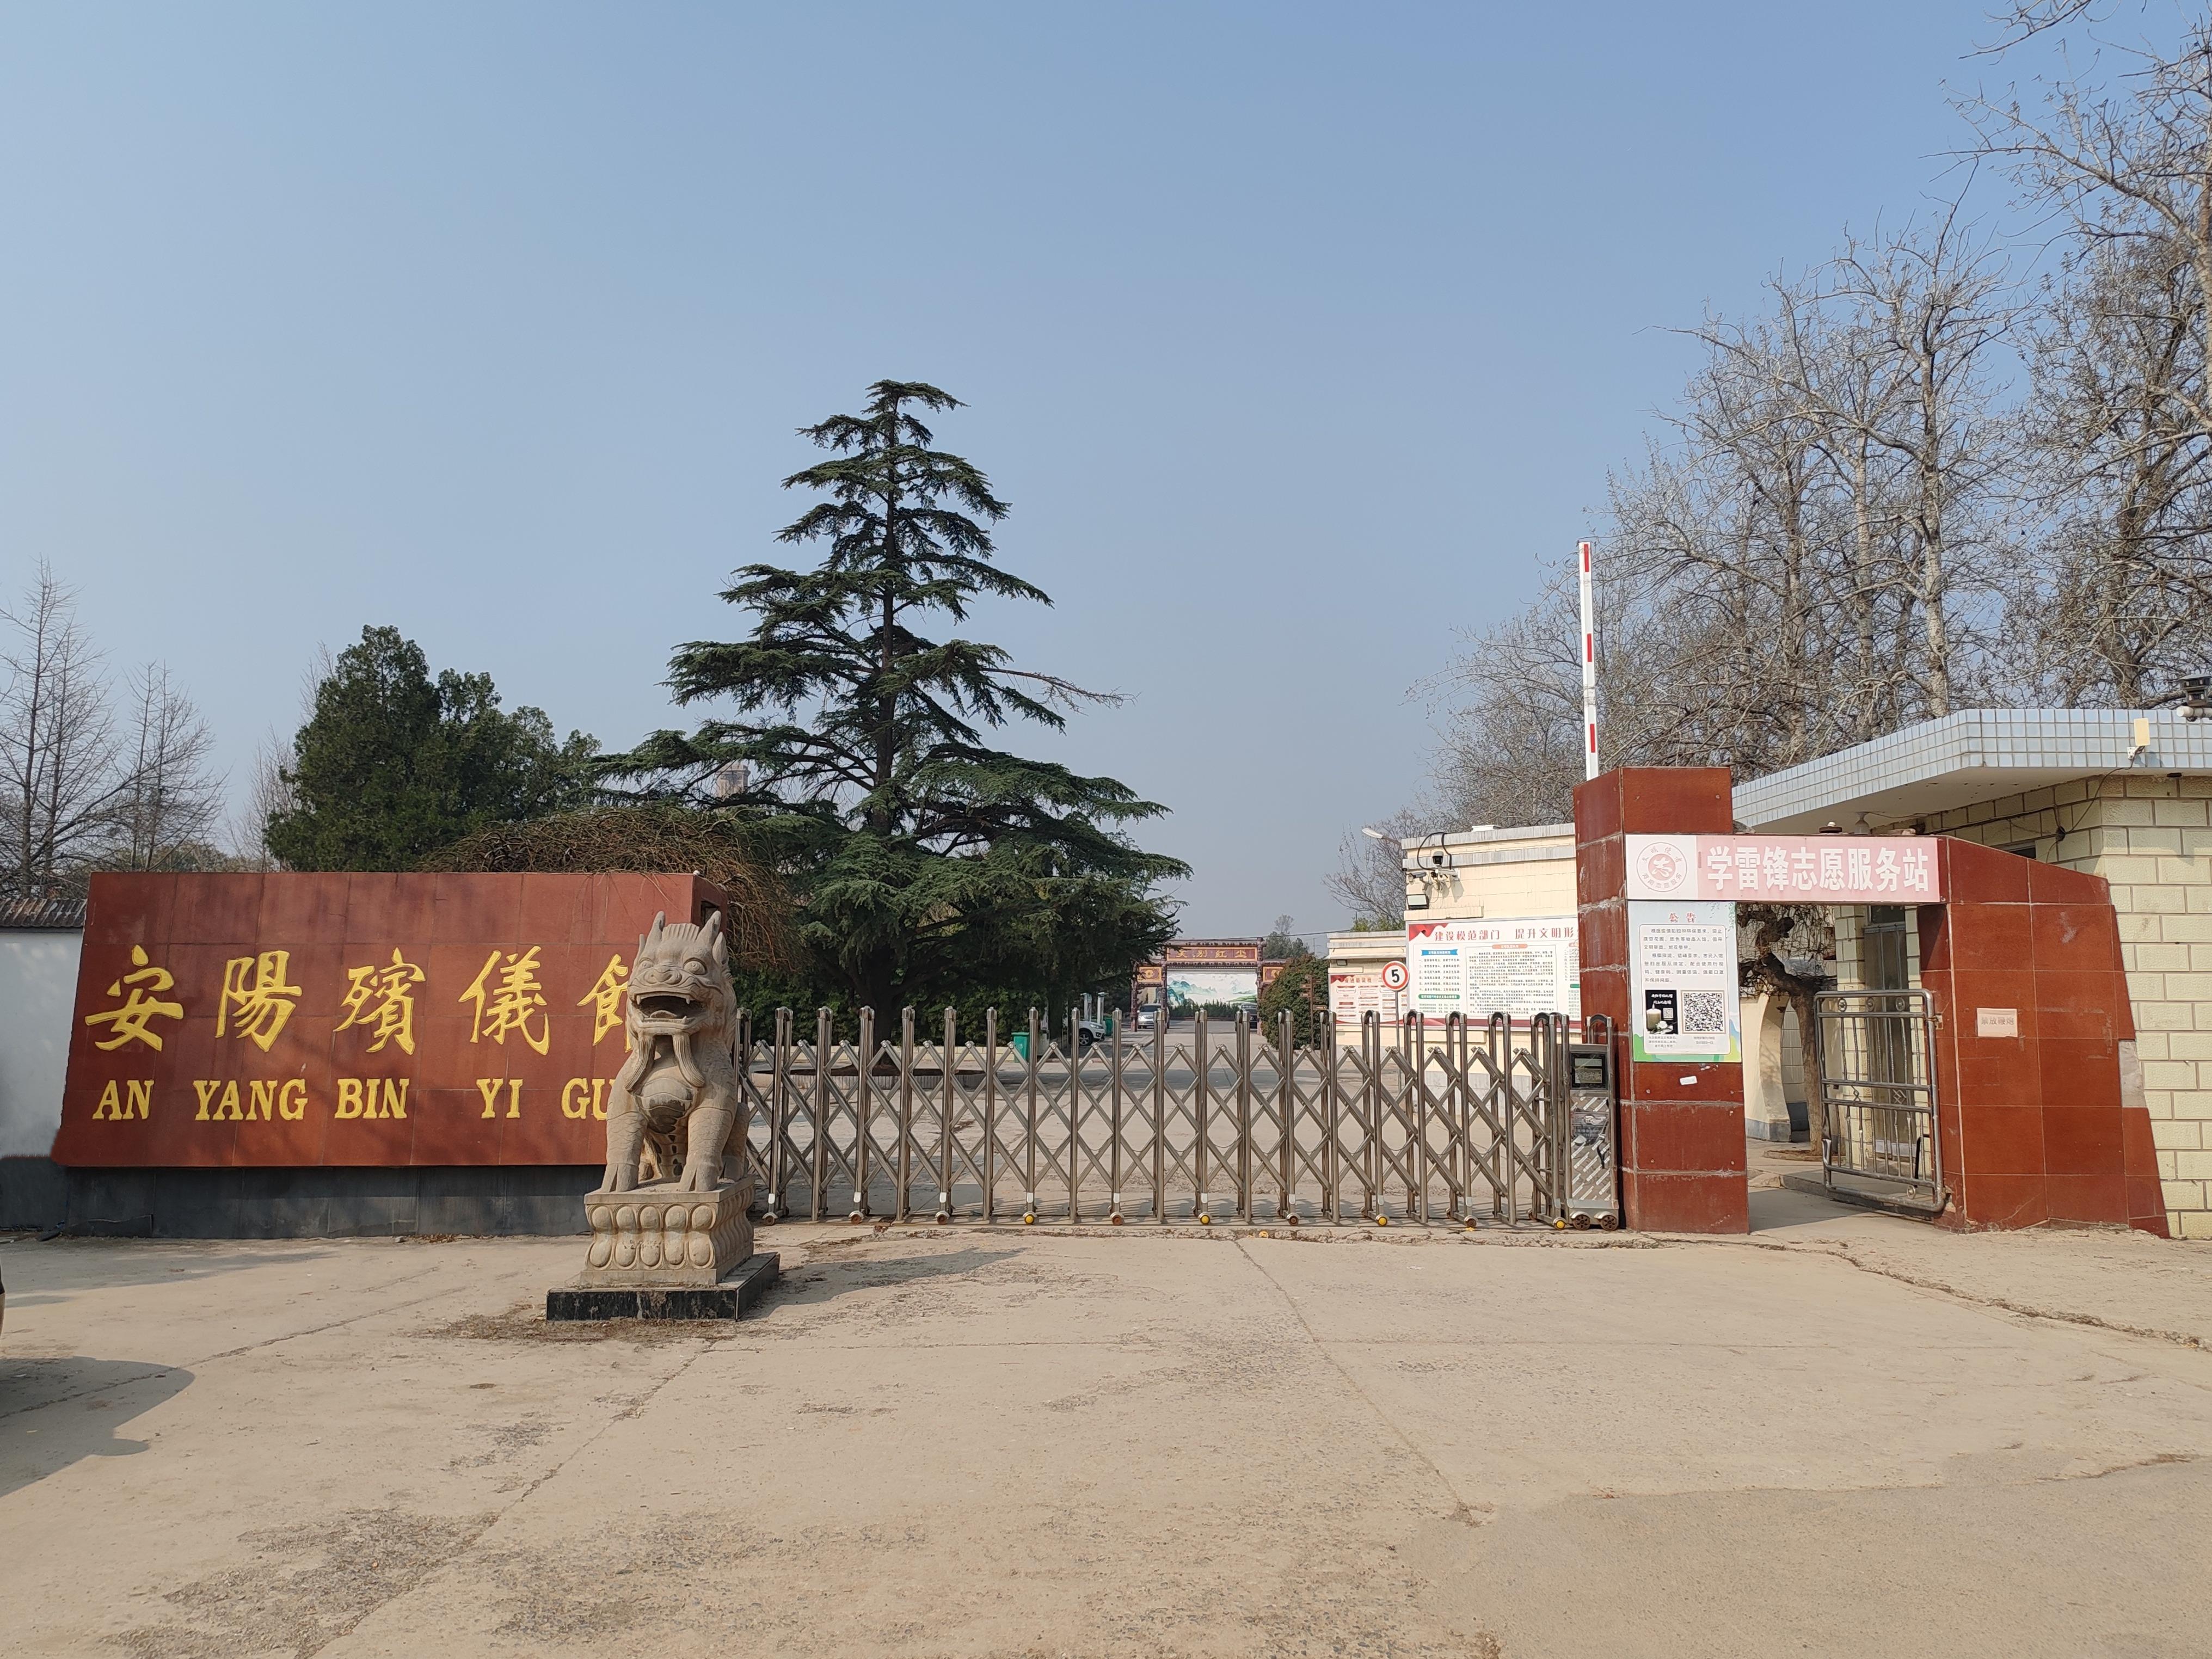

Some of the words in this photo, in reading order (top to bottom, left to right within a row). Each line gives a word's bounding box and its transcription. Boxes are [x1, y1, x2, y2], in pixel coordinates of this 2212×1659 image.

[1707, 845, 1929, 893] 学雷锋志愿服务站
[1435, 930, 1500, 942] 建设模范部门
[1515, 927, 1578, 939] 提升文明形
[1391, 969, 1400, 983] 5
[91, 1080, 155, 1121] AN
[194, 1079, 307, 1121] YANG
[334, 1078, 410, 1120] BIN
[476, 1078, 524, 1119] YI
